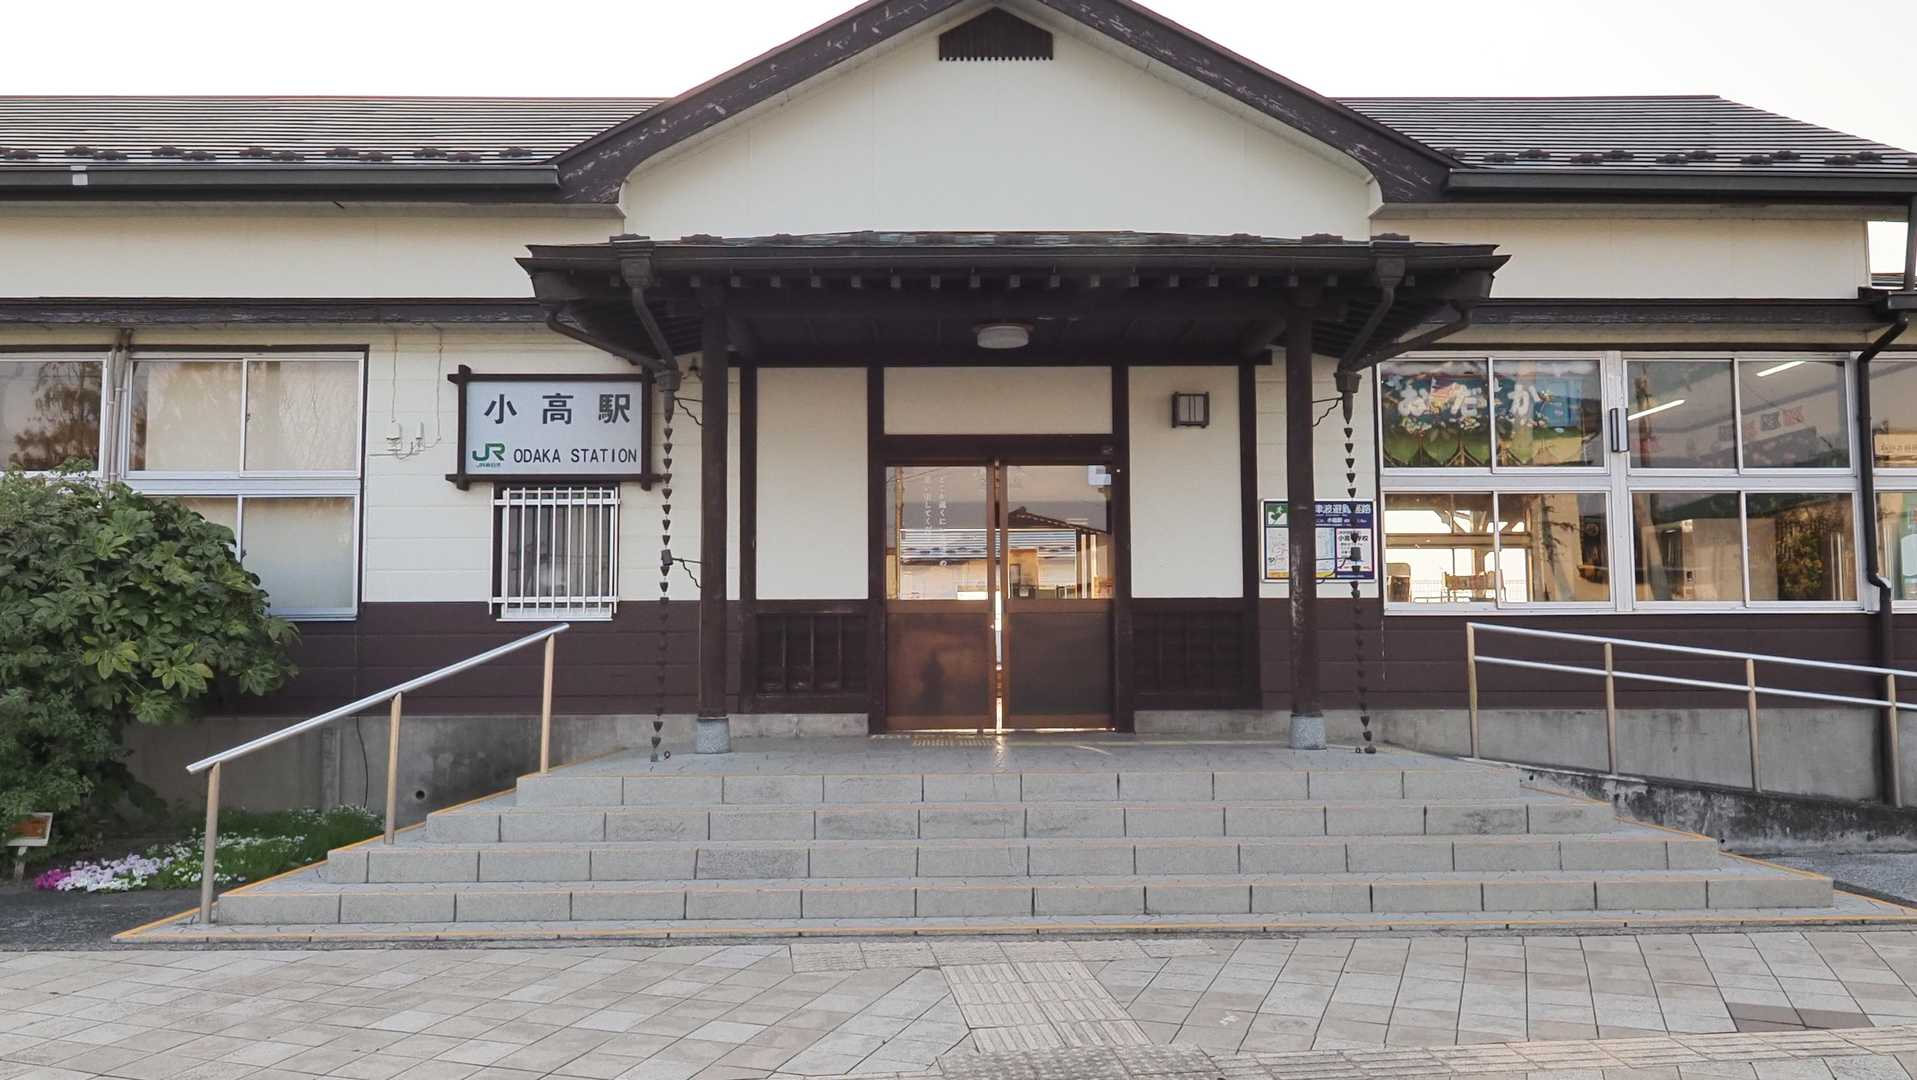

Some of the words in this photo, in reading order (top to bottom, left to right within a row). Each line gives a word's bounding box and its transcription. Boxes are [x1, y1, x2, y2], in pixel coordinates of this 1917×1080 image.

[484, 393, 631, 425] 小高駅
[472, 442, 506, 461] JR
[513, 448, 561, 463] ODAKA
[571, 447, 637, 464] STATION
